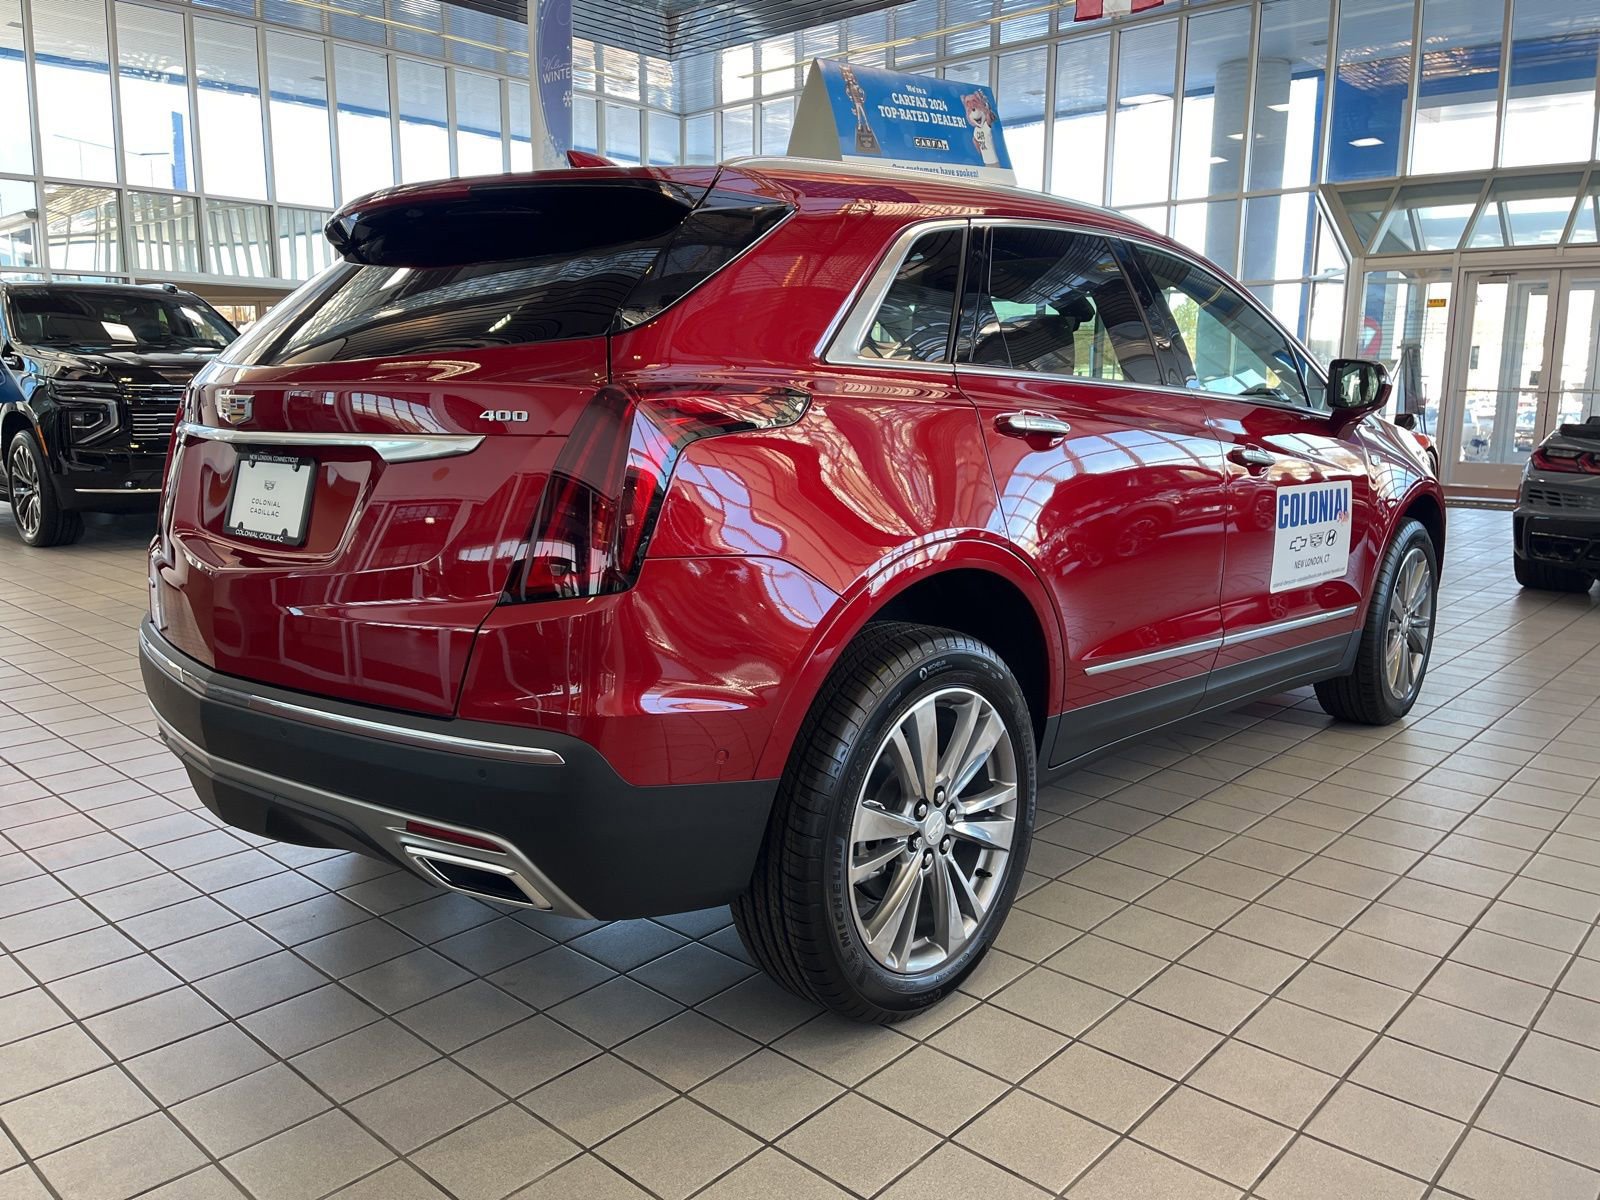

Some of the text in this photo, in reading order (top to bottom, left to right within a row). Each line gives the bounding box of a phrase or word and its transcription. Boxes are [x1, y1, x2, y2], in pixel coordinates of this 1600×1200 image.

[543, 67, 571, 84] WINTE
[891, 92, 948, 112] CARFAX 2024
[877, 105, 967, 128] TOP-RATED DEALER!
[940, 166, 955, 176] have
[479, 410, 528, 422] 400
[251, 498, 281, 508] COLONIAL
[250, 507, 280, 518] CADILLAC
[235, 529, 284, 542] COLONIAL CADILLAC
[1294, 560, 1304, 569] NEW
[832, 842, 852, 949] MICHELIN
